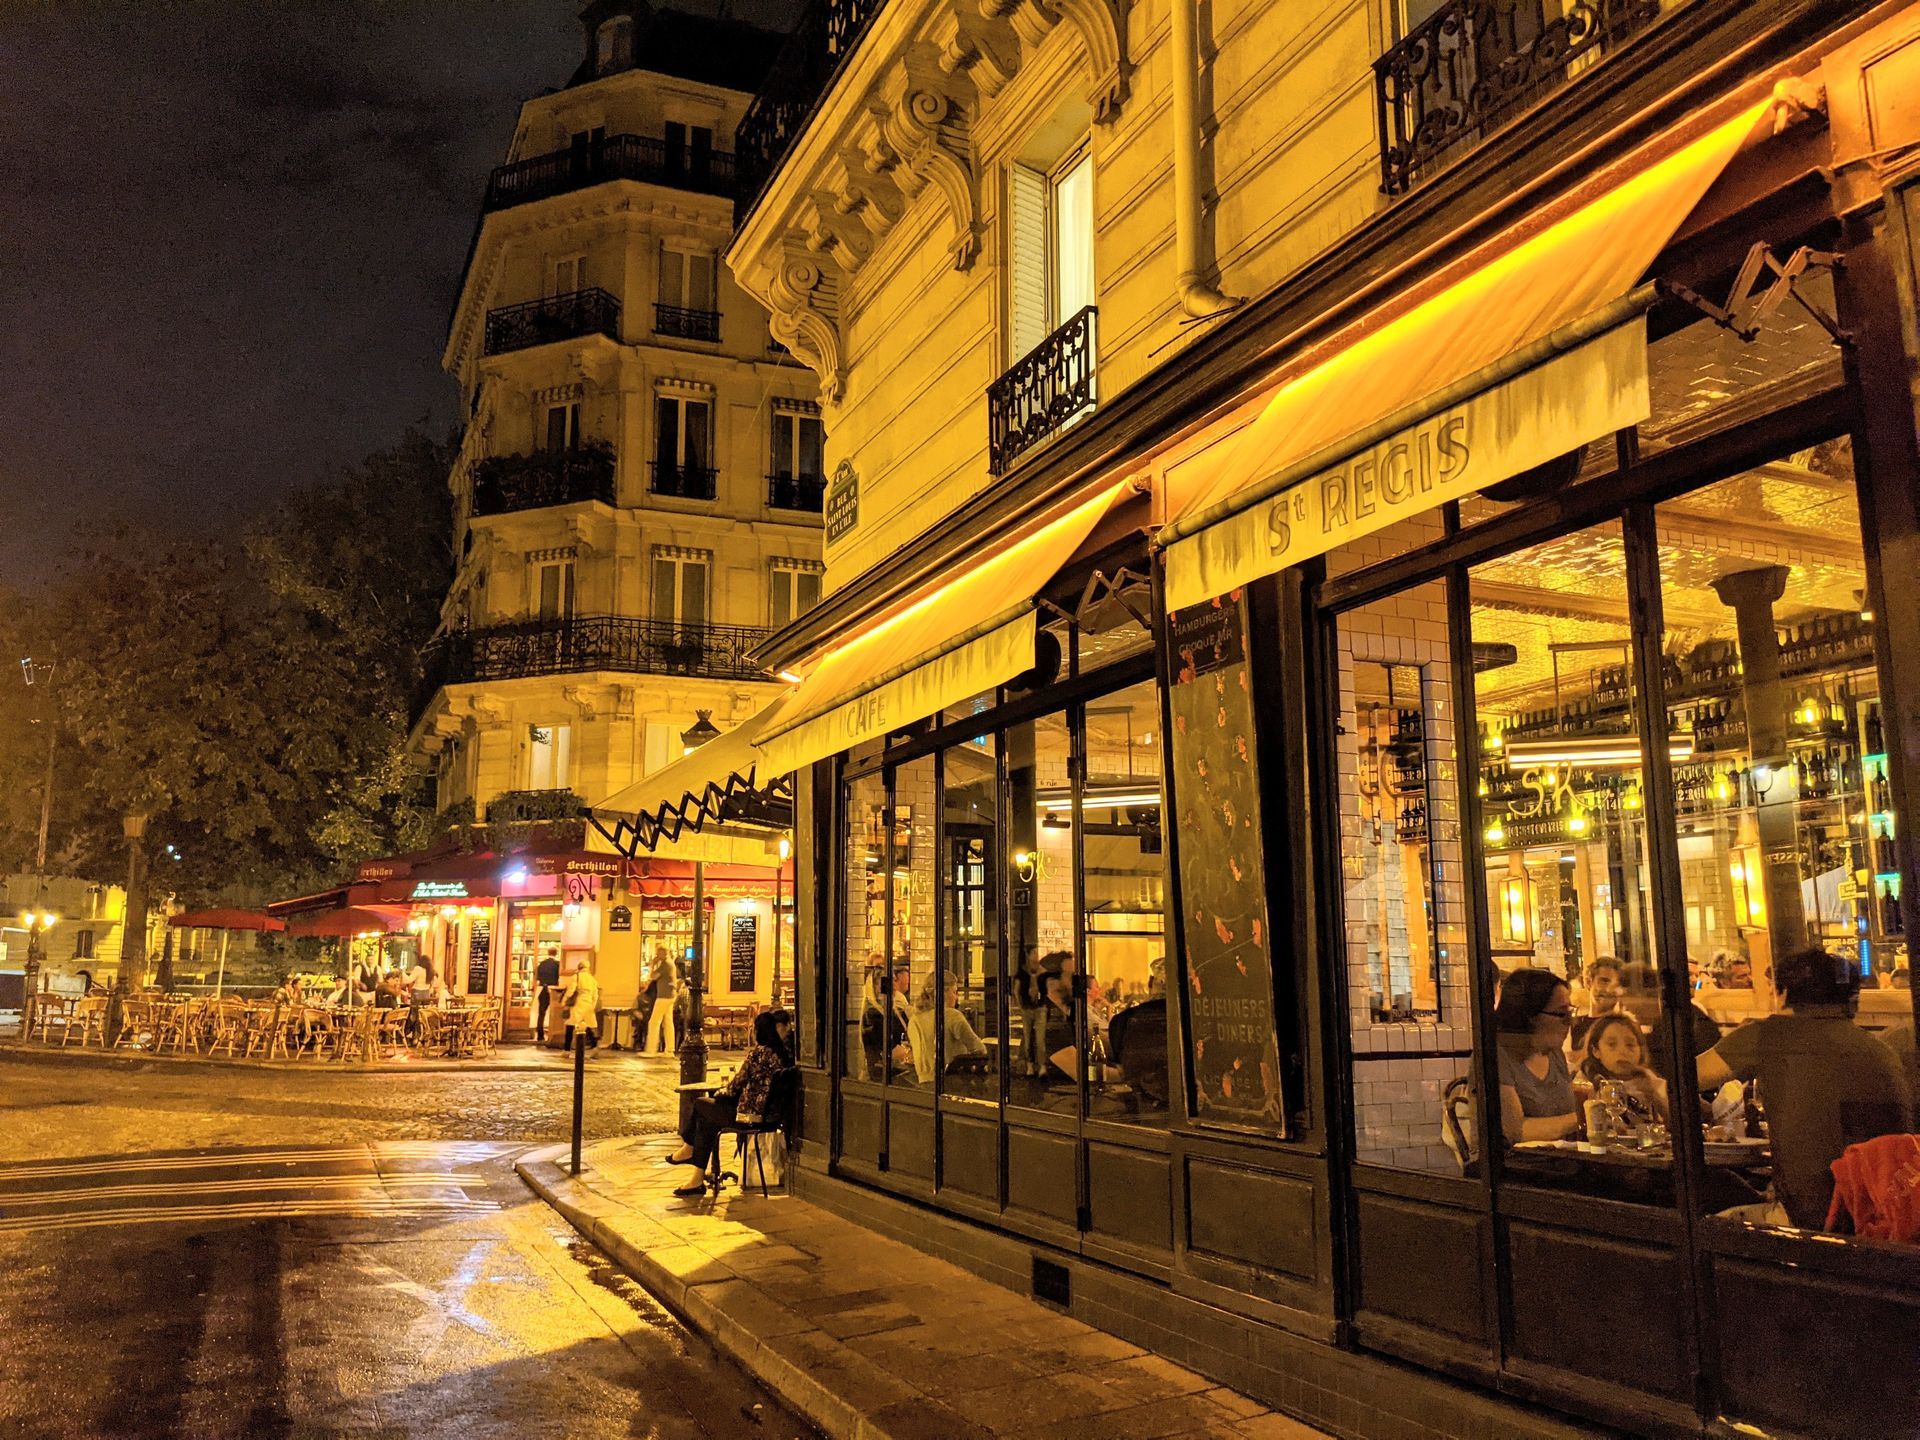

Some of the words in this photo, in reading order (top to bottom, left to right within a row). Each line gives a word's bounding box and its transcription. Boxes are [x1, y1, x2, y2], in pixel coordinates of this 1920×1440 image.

[1320, 416, 1471, 535] REGIS
[837, 492, 847, 508] RUE
[842, 496, 857, 516] LOUIS
[1175, 606, 1235, 636] HAMBURGERS
[1179, 634, 1215, 655] CROQUE
[566, 861, 618, 872] Berthillon
